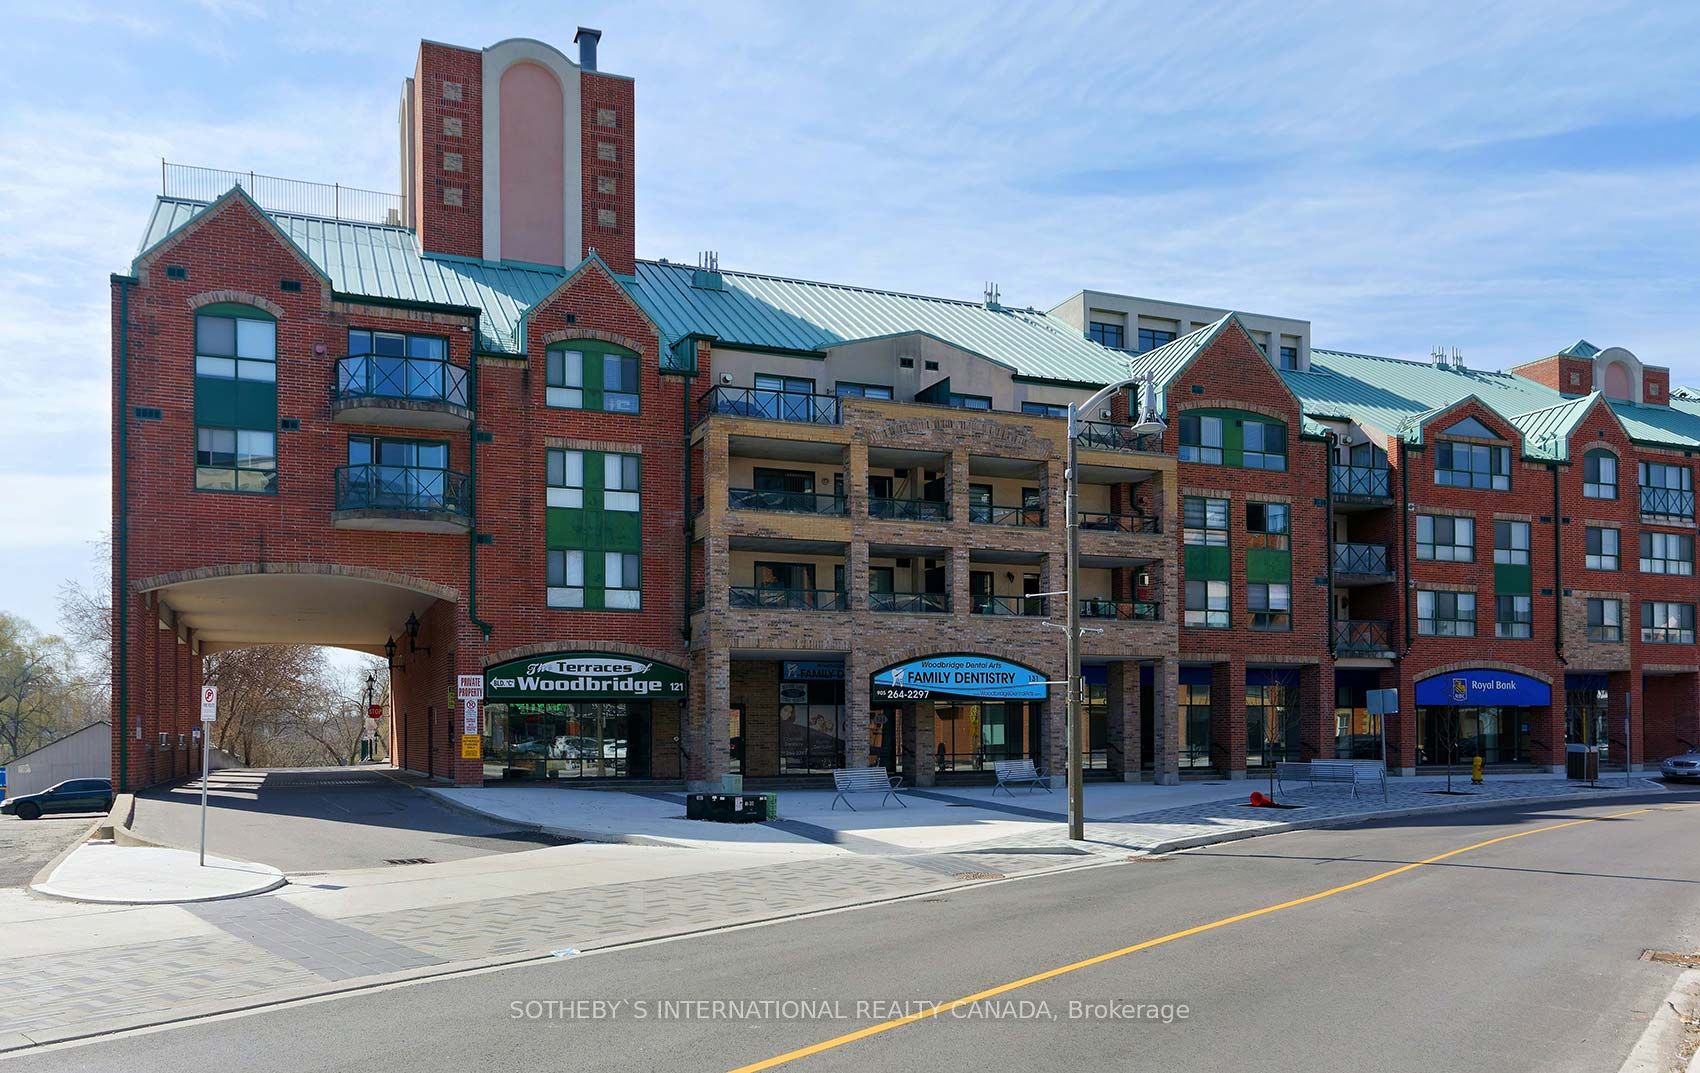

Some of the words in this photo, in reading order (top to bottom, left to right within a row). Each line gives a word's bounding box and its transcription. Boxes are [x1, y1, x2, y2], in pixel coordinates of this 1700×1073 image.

[556, 661, 633, 673] Terraces
[639, 662, 653, 674] of
[921, 661, 964, 670] Woodbridge
[800, 669, 834, 679] FAMILY
[908, 672, 951, 684] FAMILY
[955, 672, 1016, 684] DENTISTRY
[1028, 675, 1039, 683] 131
[460, 677, 481, 687] PRIVATE
[517, 676, 663, 694] Woodbridge
[669, 682, 684, 692] 121
[1472, 679, 1494, 692] Royal
[1495, 680, 1517, 690] Bank
[458, 688, 482, 698] PROPERTY
[887, 690, 930, 699] 264-2297
[368, 708, 383, 716] STOP
